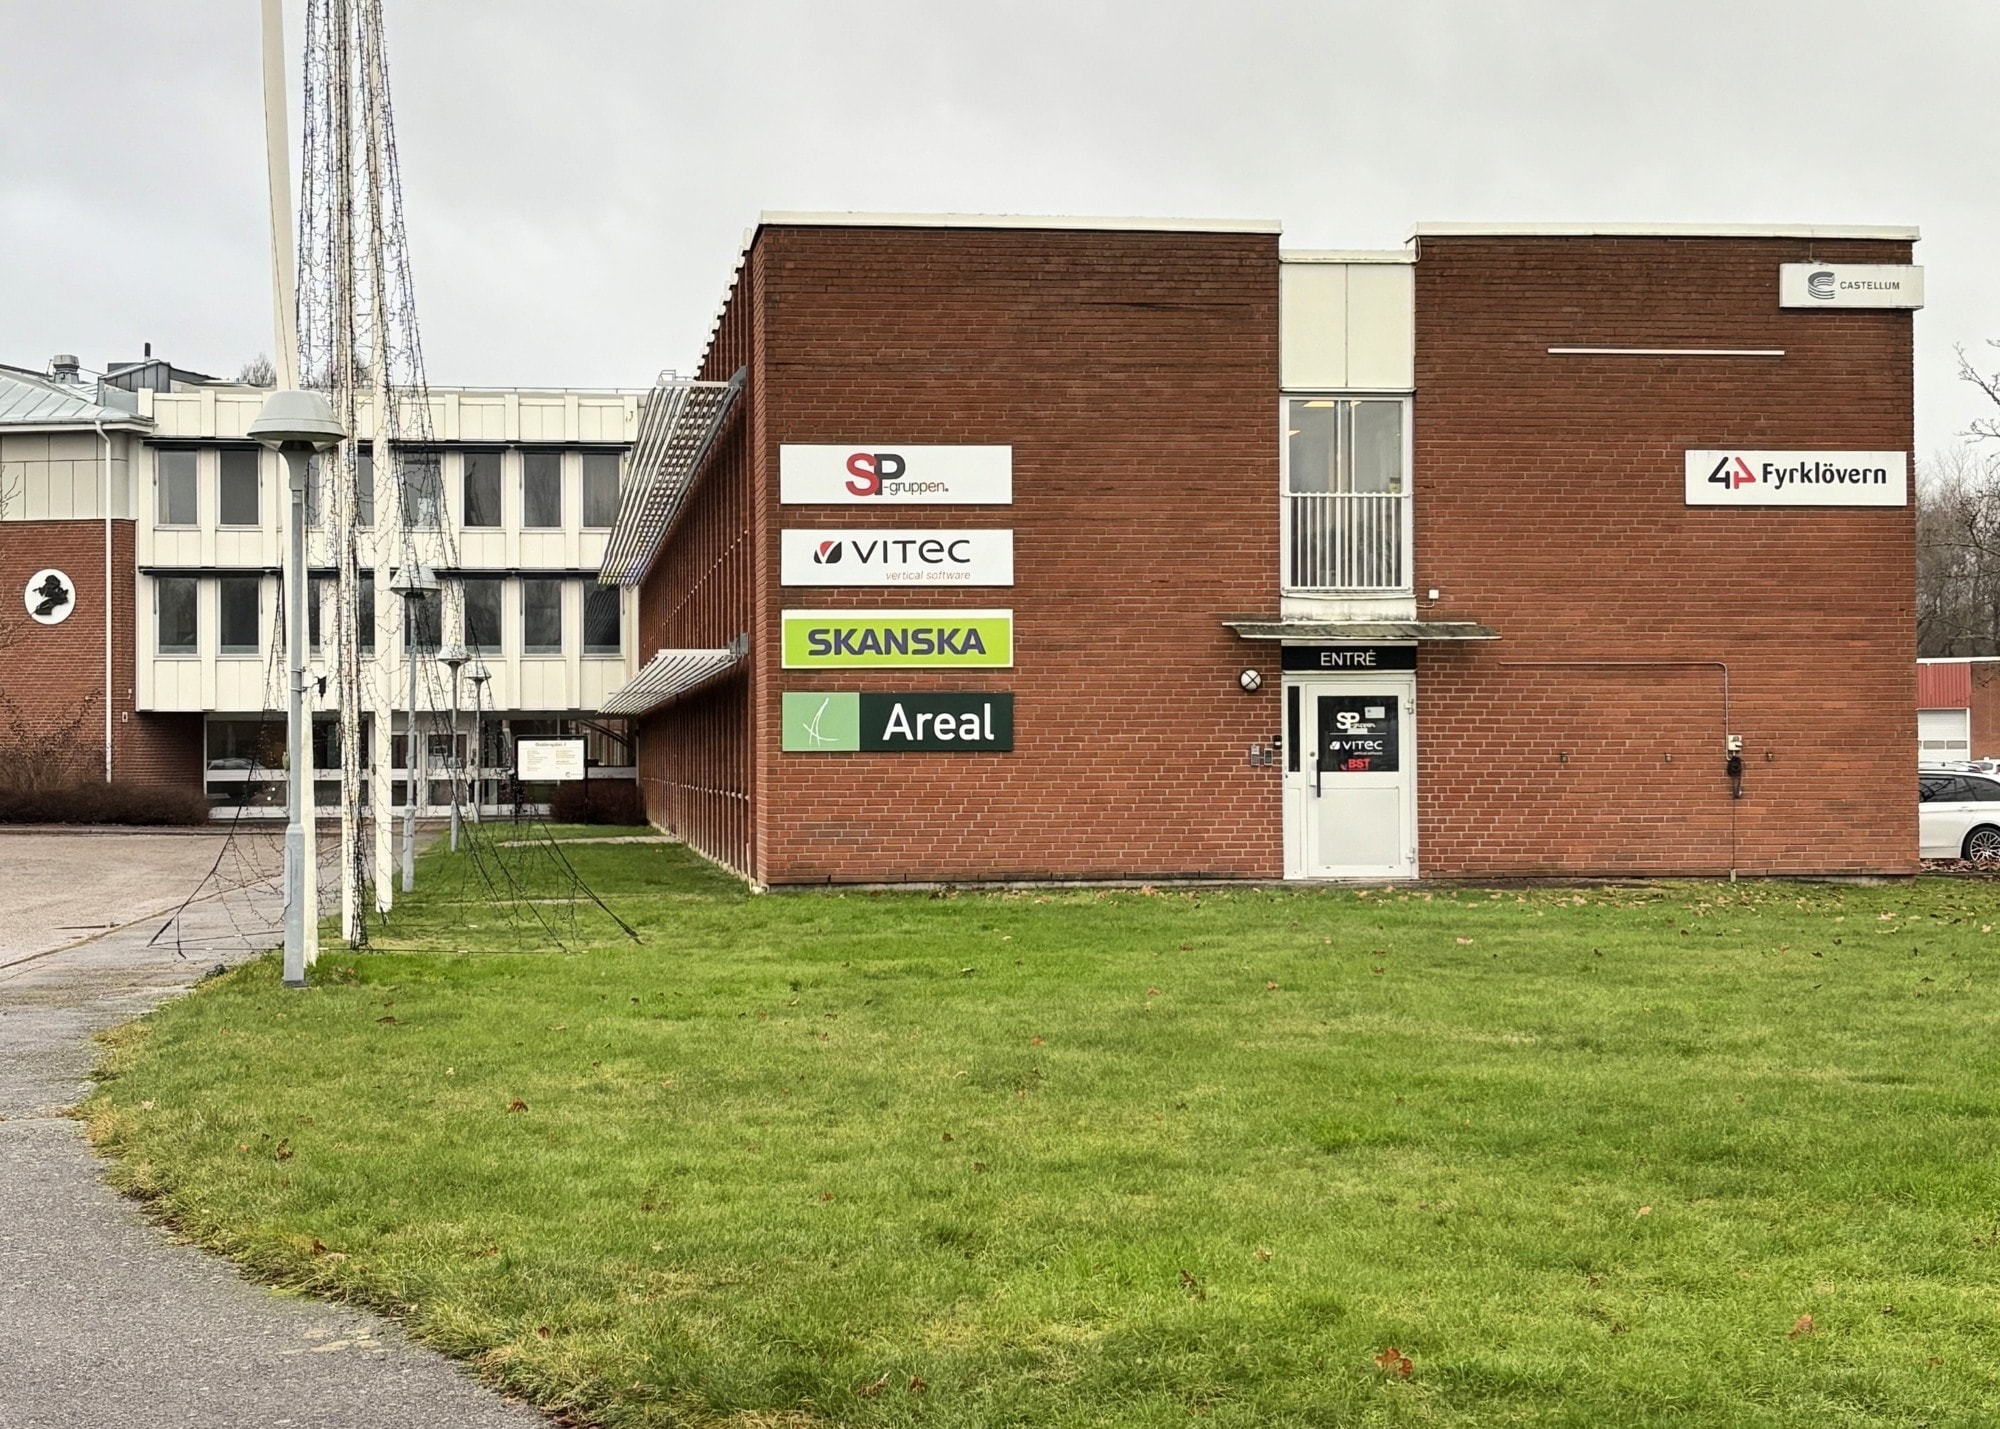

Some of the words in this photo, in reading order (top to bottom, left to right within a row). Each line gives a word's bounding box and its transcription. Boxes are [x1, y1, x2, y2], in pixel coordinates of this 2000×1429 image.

[1840, 281, 1900, 290] CASTELLUM
[1762, 462, 1887, 490] Fyrklövern
[885, 571, 923, 580] vertical
[926, 571, 971, 580] software
[808, 628, 986, 656] SKANSKA
[1320, 650, 1376, 666] ENTRÉ
[882, 703, 995, 741] Areal
